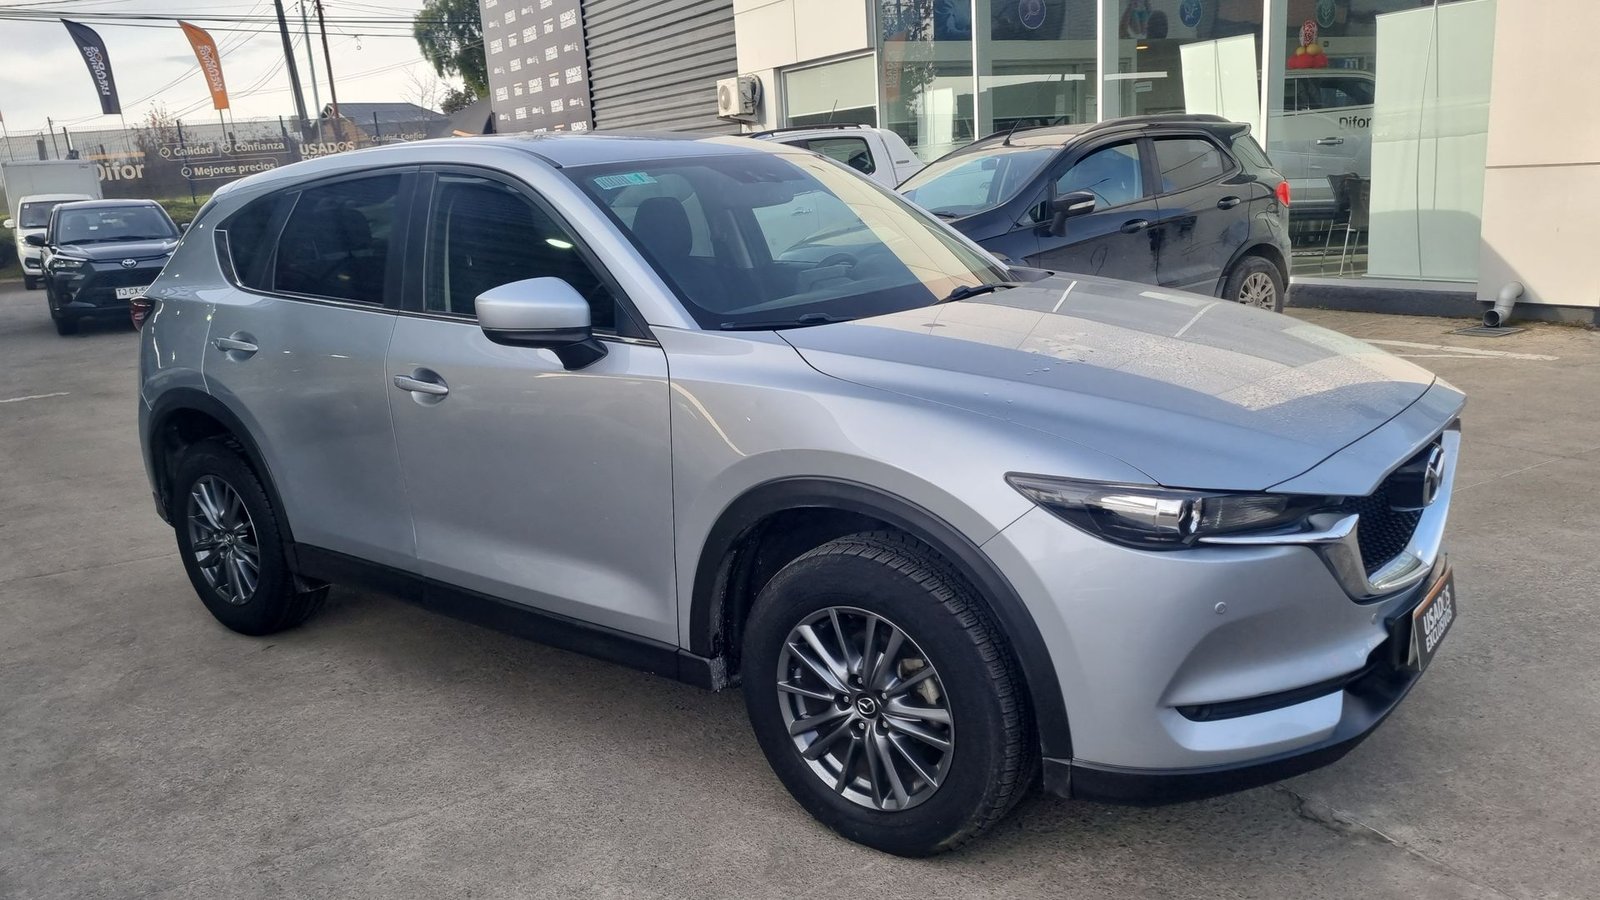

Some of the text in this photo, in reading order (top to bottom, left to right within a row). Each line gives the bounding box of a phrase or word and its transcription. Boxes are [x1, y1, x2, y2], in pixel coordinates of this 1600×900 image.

[173, 145, 214, 157] Calidad
[234, 141, 285, 152] Confianza
[298, 141, 355, 155] USADOS
[194, 162, 276, 177] Mejores precios
[1423, 584, 1451, 635] USADOS
